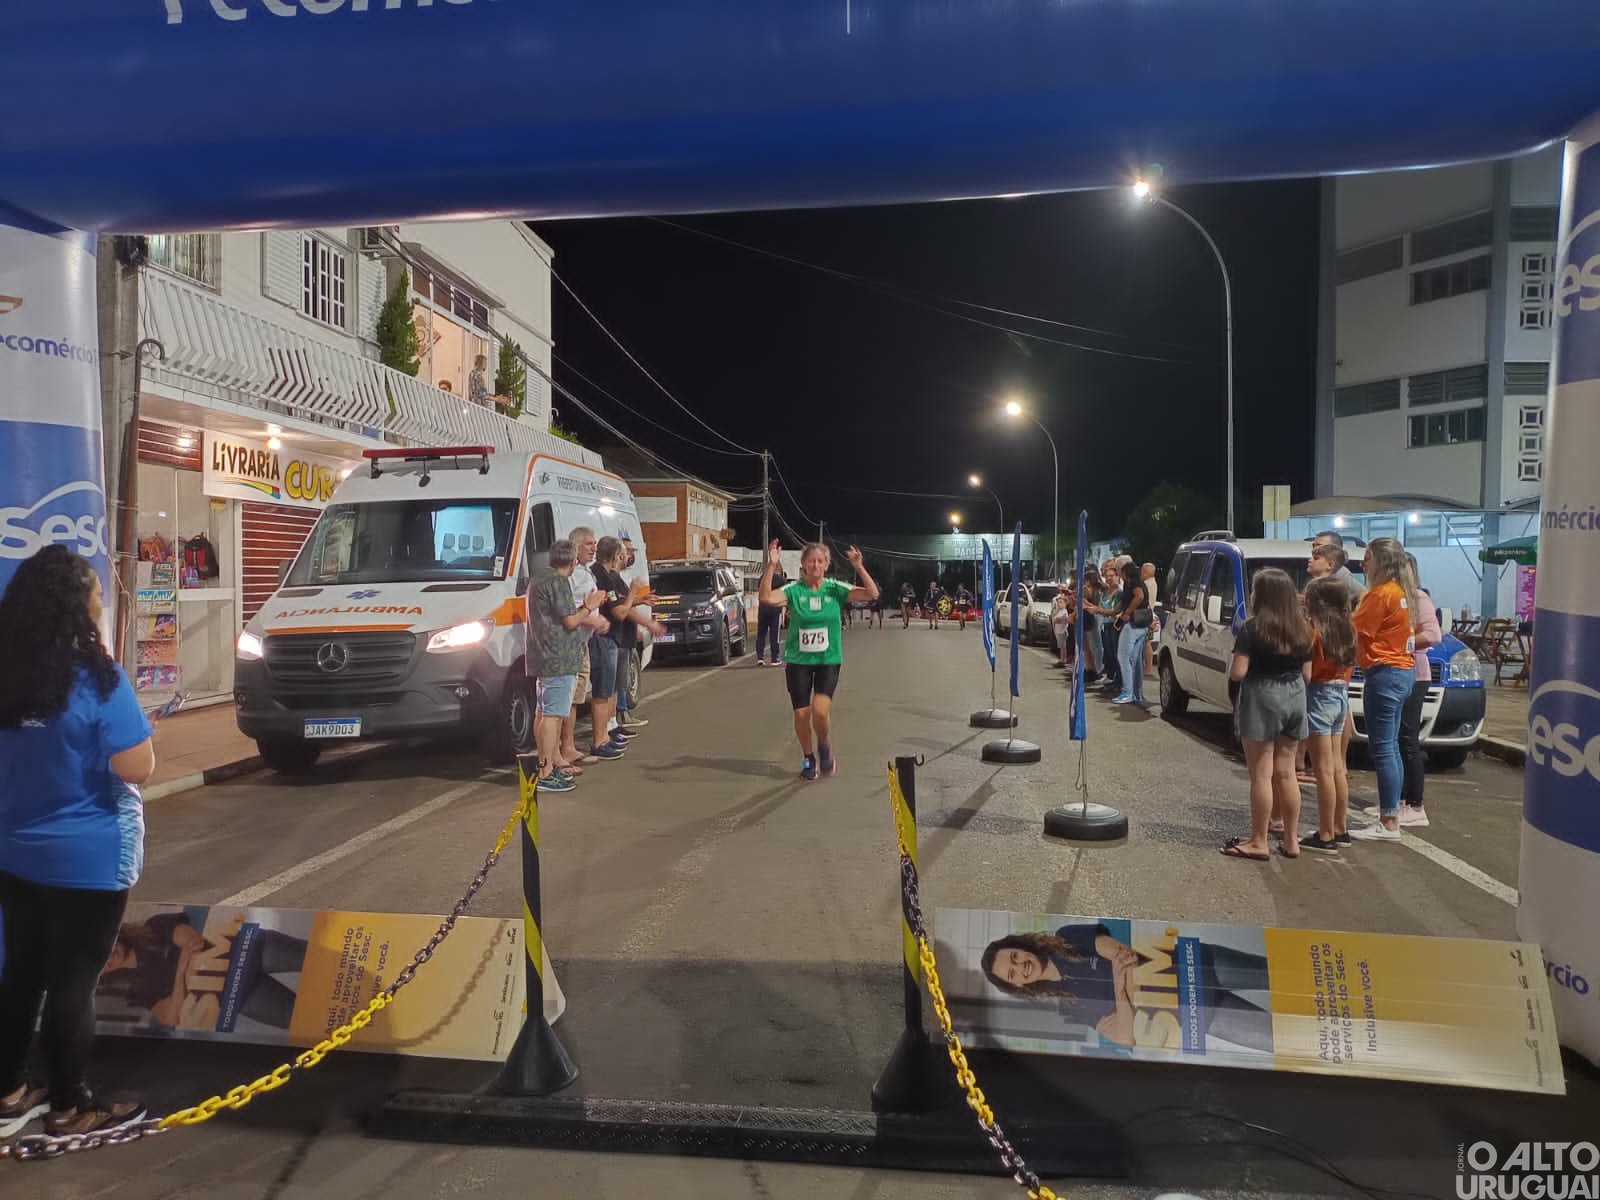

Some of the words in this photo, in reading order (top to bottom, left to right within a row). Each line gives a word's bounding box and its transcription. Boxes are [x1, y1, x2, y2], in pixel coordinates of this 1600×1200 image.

[801, 632, 825, 646] 875
[332, 972, 344, 1001] todo
[340, 927, 354, 969] mundo
[342, 943, 360, 1003] aproveitar
[356, 926, 364, 940] os
[1310, 944, 1323, 987] mundo
[1322, 943, 1331, 957] os
[356, 966, 365, 981] do
[1187, 966, 1195, 983] SER
[1357, 958, 1371, 990] você.
[1542, 958, 1590, 995] rcio
[224, 999, 235, 1029] TODOS
[230, 969, 243, 999] PODEM
[1188, 985, 1197, 1016] PODEM
[1315, 991, 1326, 1022] todo
[1324, 959, 1339, 1025] aproveitar
[1337, 983, 1348, 1001] do
[1190, 1018, 1199, 1049] TODOS
[1341, 1004, 1353, 1062] serviços
[1364, 994, 1377, 1052] Inclusive
[1319, 1025, 1330, 1061] Aqui,
[1329, 1030, 1343, 1065] pode
